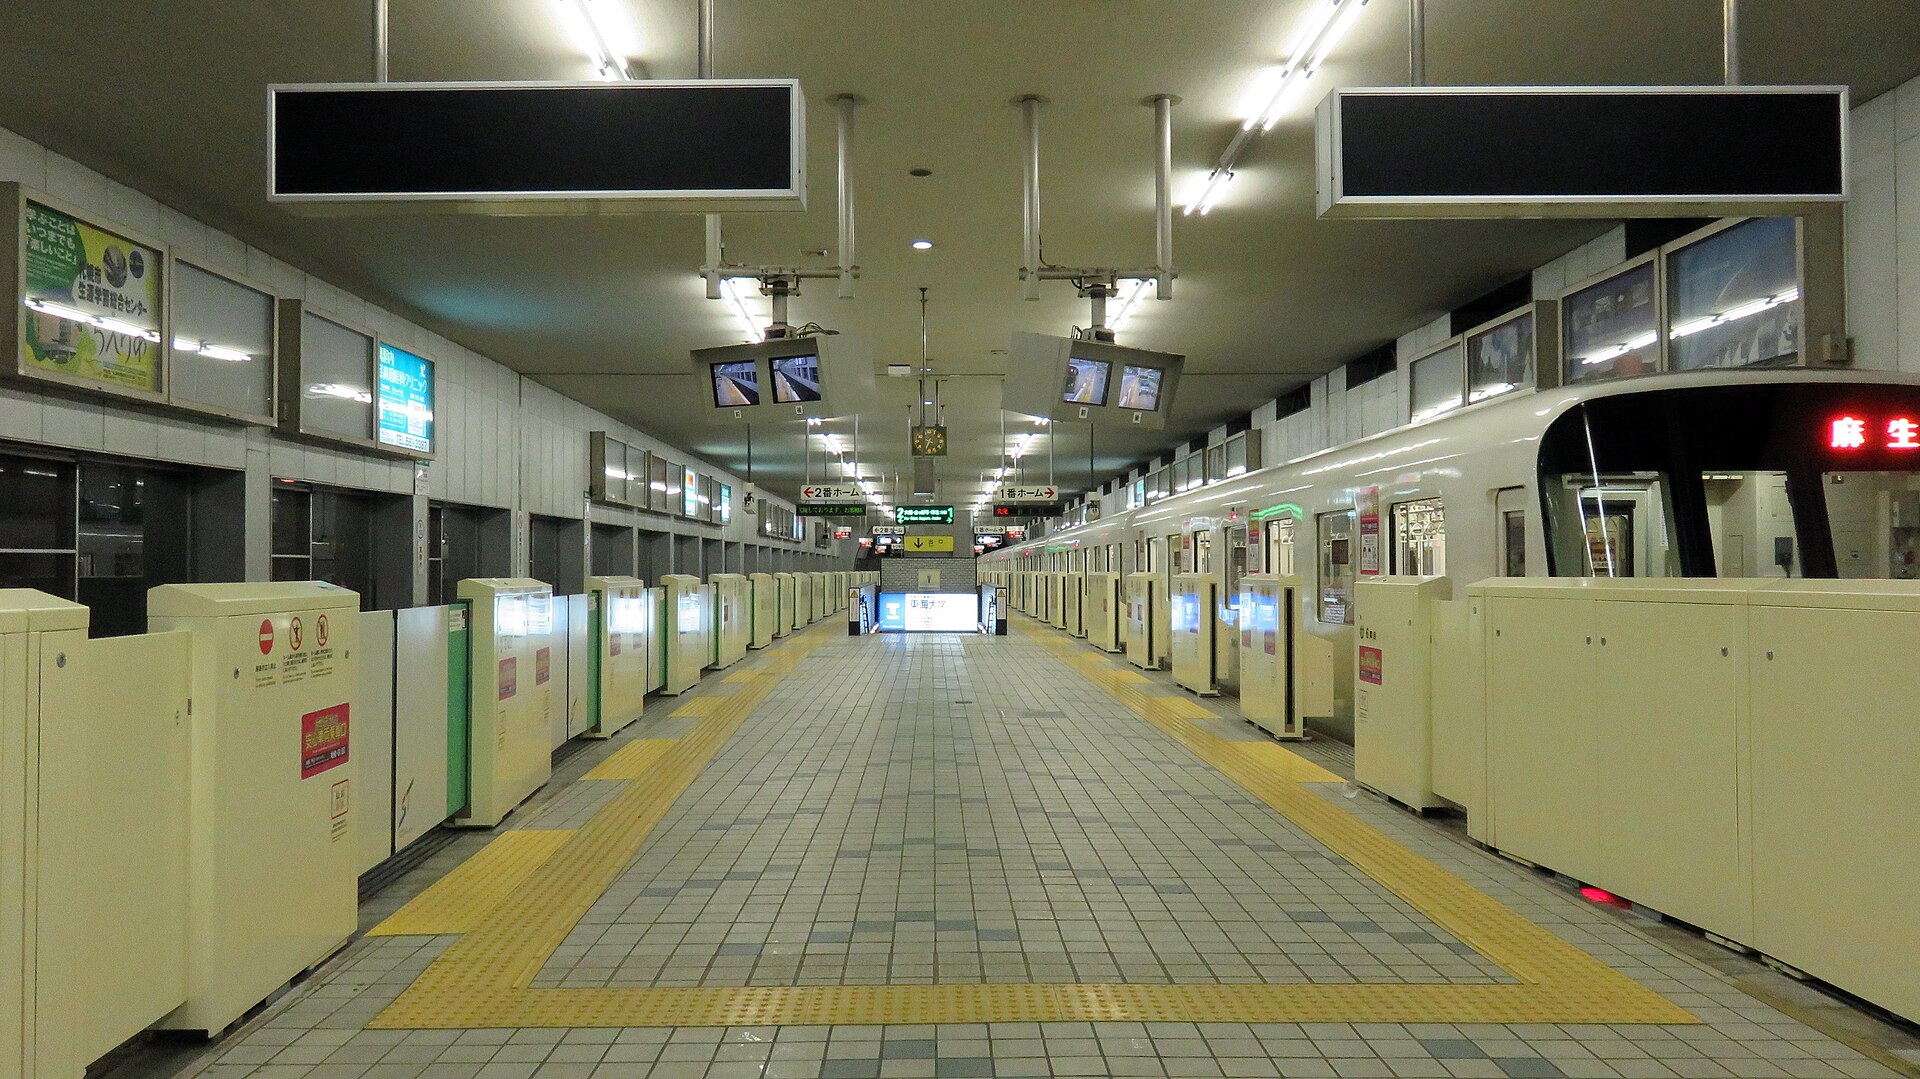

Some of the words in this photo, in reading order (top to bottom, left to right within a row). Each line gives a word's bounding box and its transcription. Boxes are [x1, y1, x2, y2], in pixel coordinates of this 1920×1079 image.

[1831, 416, 1920, 448] 麻生
[815, 488, 860, 498] 2番ホーム
[1000, 488, 1043, 498] 1番ホーム
[896, 507, 904, 518] 2
[947, 507, 953, 518] 1
